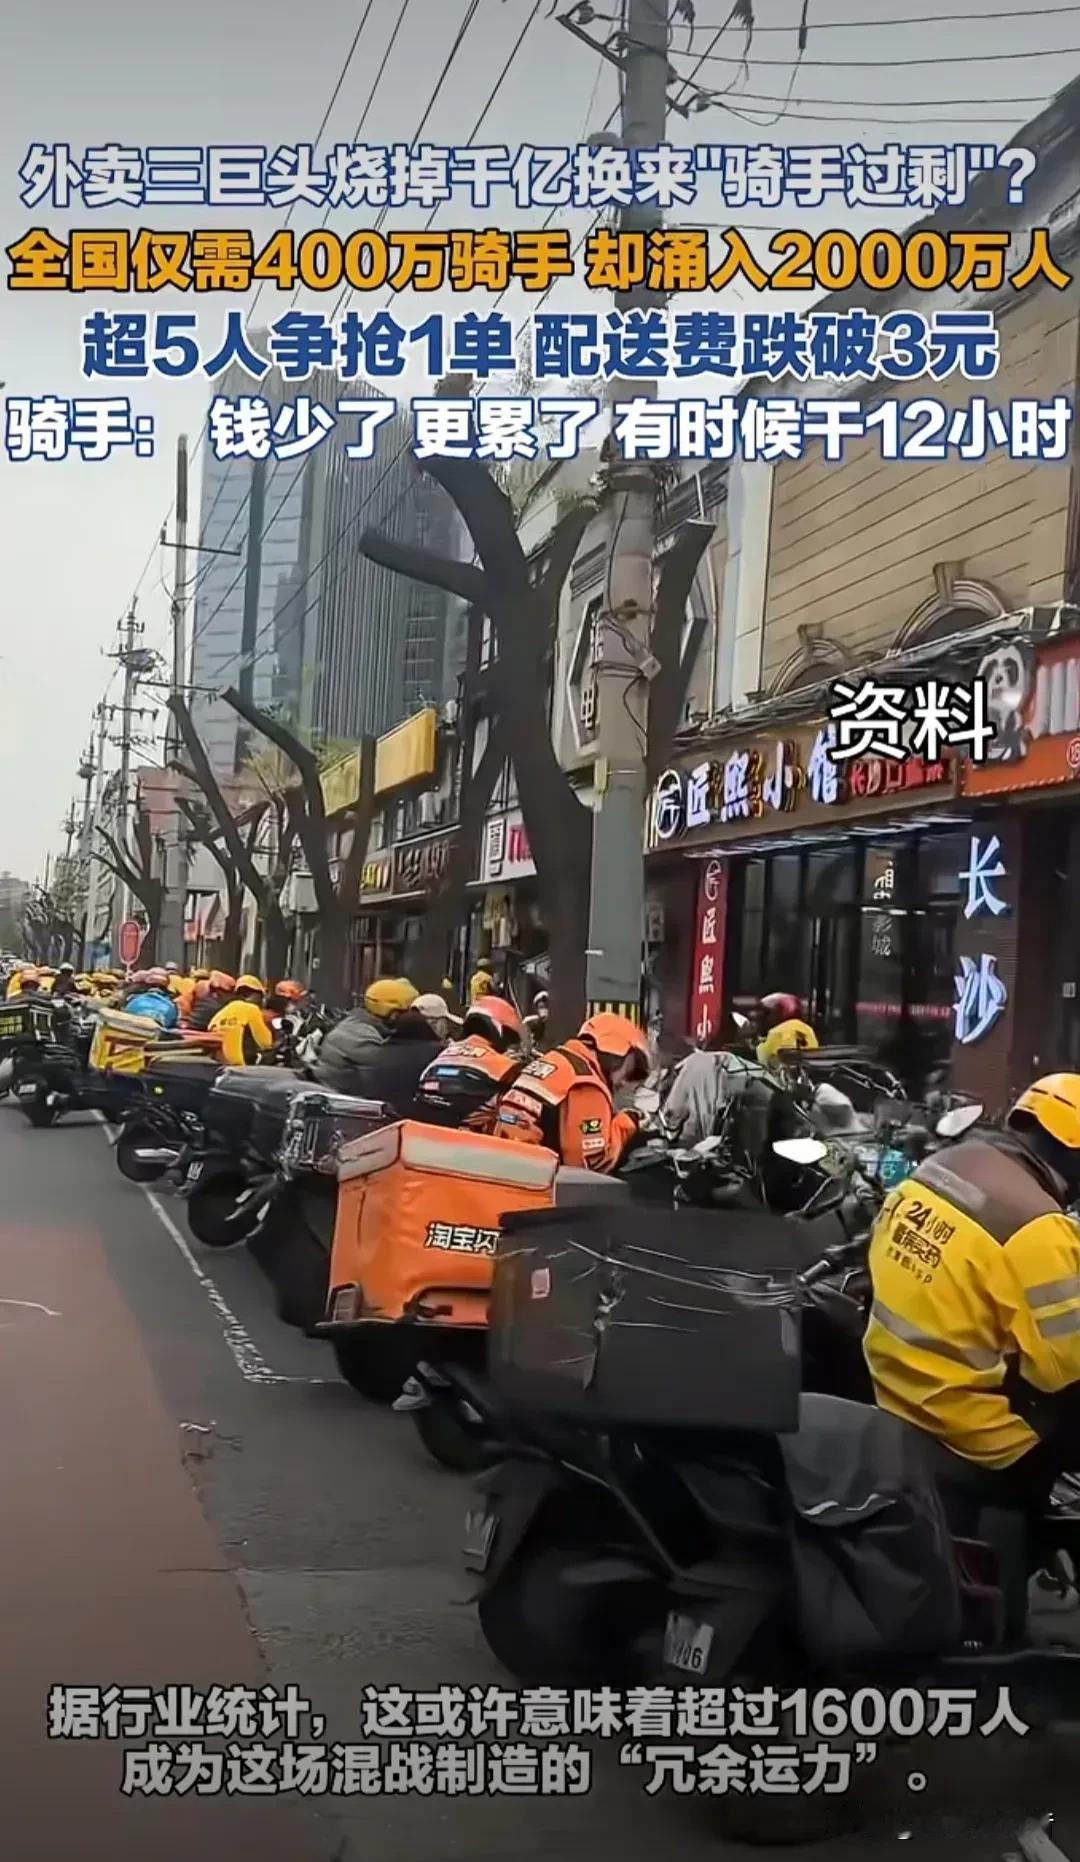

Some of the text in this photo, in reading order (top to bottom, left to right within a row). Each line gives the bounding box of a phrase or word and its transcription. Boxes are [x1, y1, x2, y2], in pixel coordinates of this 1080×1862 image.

[951, 835, 1008, 1045] 长沙
[424, 1222, 501, 1255] 淘宝闪
